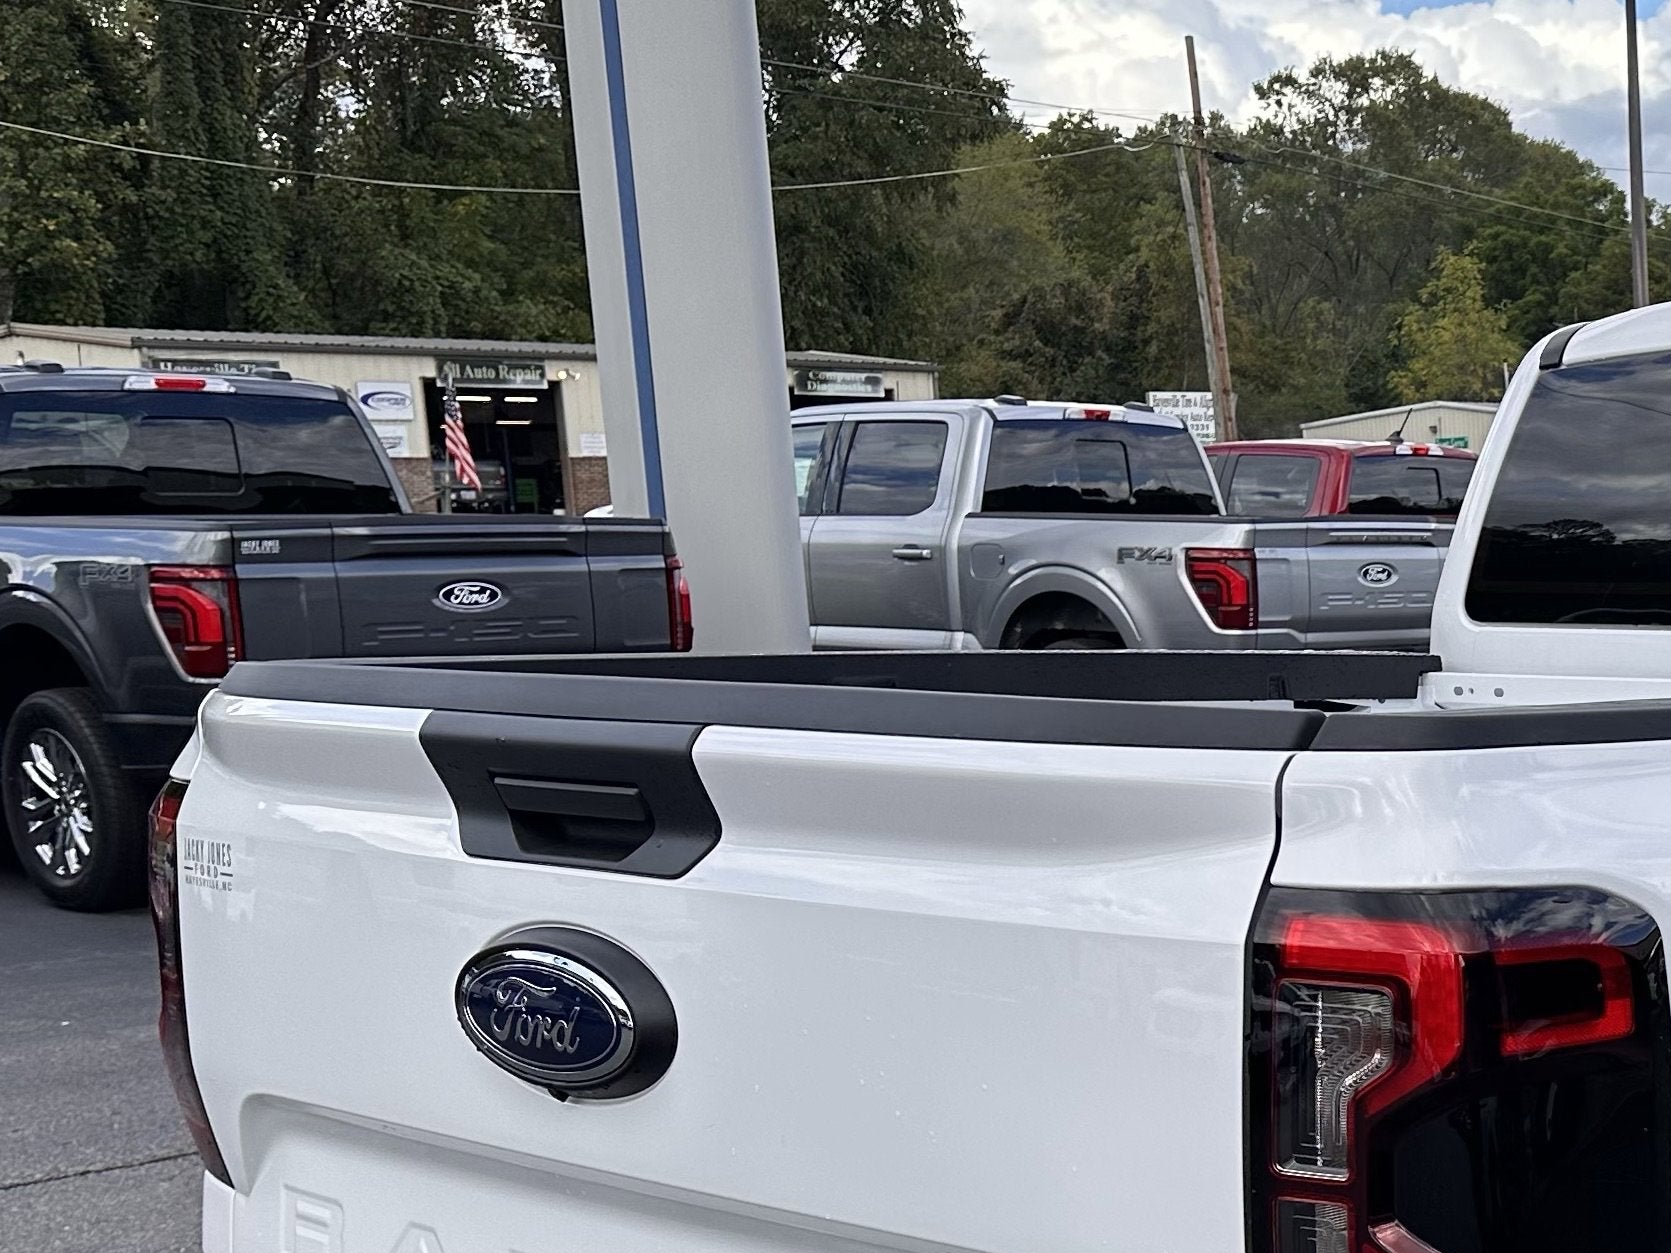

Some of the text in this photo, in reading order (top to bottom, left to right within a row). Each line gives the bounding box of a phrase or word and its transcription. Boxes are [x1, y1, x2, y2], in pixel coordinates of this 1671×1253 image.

[464, 364, 496, 379] Auto
[499, 365, 542, 383] Repair
[1116, 546, 1173, 564] FX4
[79, 563, 133, 587] FX4
[450, 584, 492, 604] Ford
[207, 840, 232, 867] JONES
[194, 863, 219, 879] FORD
[490, 976, 580, 1054] Ford
